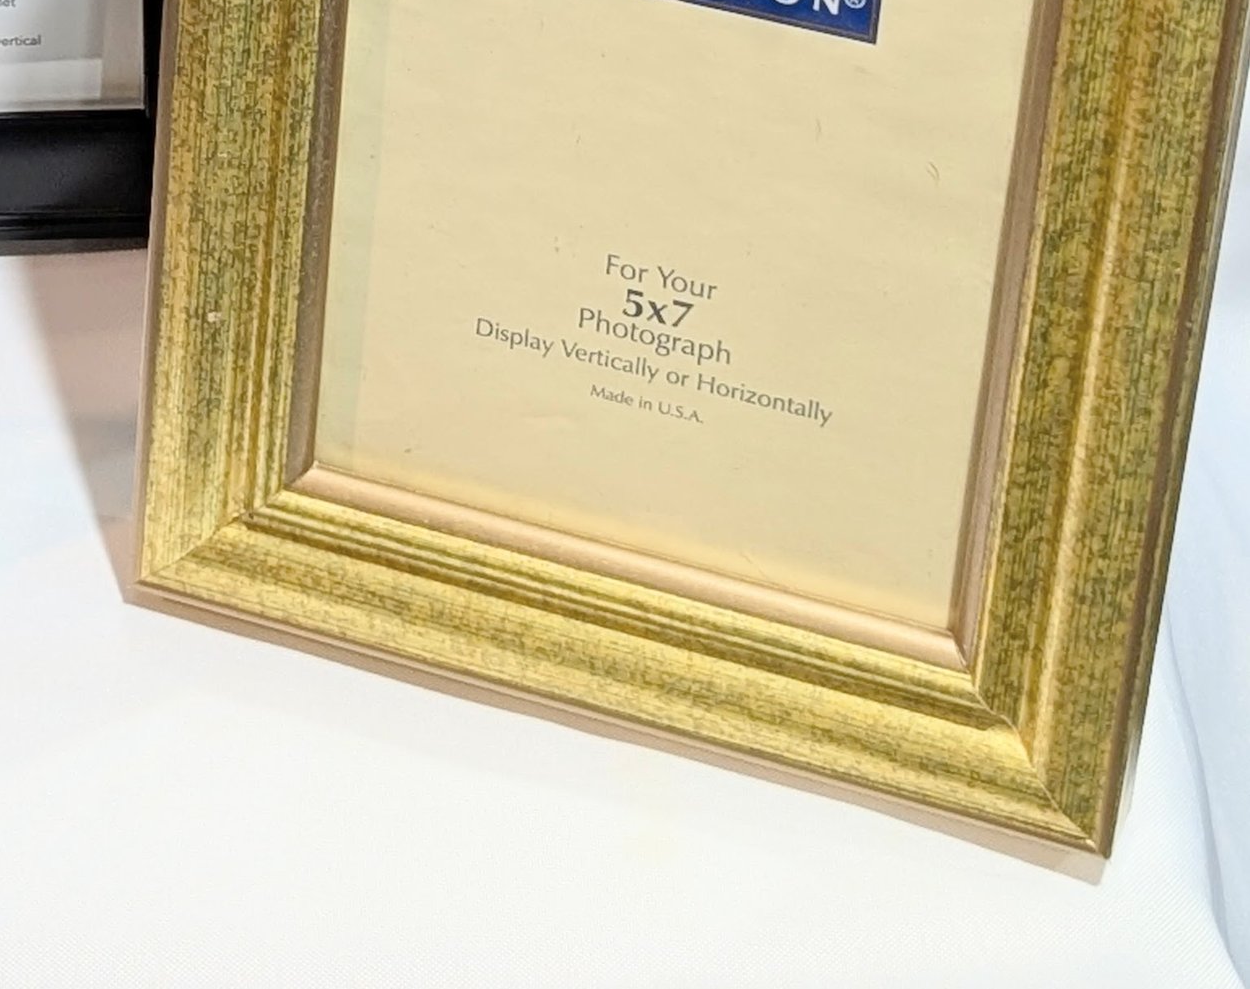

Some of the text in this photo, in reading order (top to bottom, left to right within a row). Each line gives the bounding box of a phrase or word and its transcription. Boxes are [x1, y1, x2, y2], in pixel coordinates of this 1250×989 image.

[605, 253, 718, 301] For Your
[622, 288, 694, 328] 5x7
[578, 307, 732, 366] Photograph
[475, 317, 833, 428] Display Vertically or Horizontally
[590, 383, 704, 424] Made in U.S.A.
